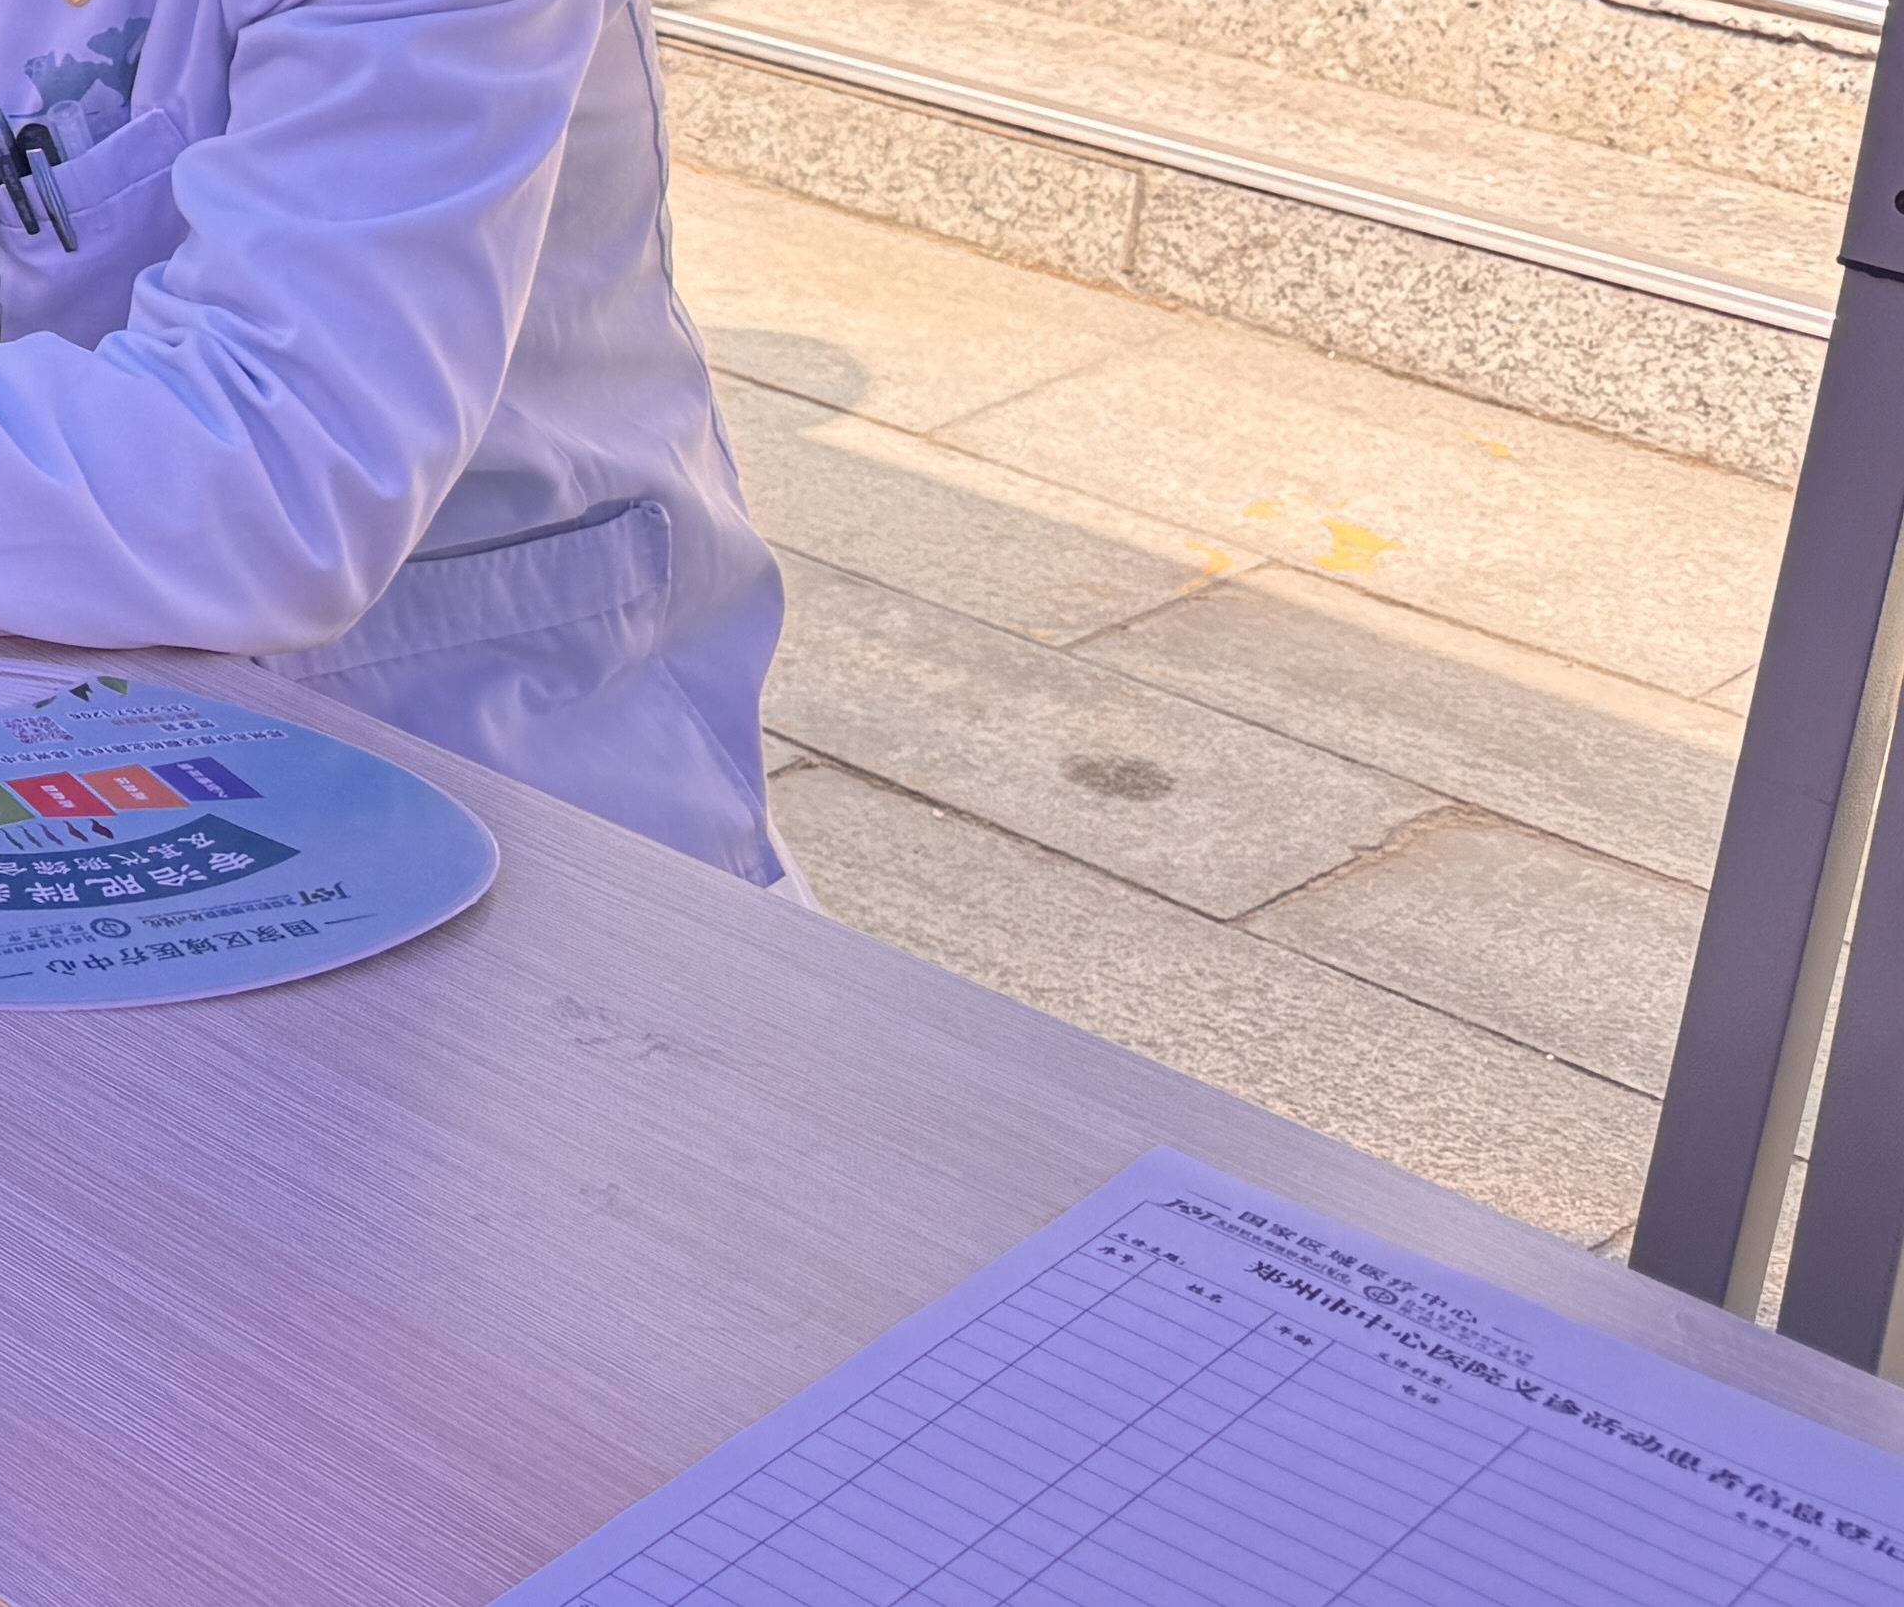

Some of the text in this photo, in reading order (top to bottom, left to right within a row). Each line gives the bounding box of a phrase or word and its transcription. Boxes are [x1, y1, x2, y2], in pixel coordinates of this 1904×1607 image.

[43, 918, 317, 979] 国家区域医疗中心
[1097, 1244, 1138, 1265] 序号
[1237, 1210, 1478, 1324] 国家区域医疗中心
[1185, 1282, 1226, 1305] 姓名
[1273, 1324, 1315, 1349] 年龄
[1401, 1383, 1442, 1406] 电话
[1242, 1260, 1904, 1564] 郑州市中心医院义诊活动患者信息登记
